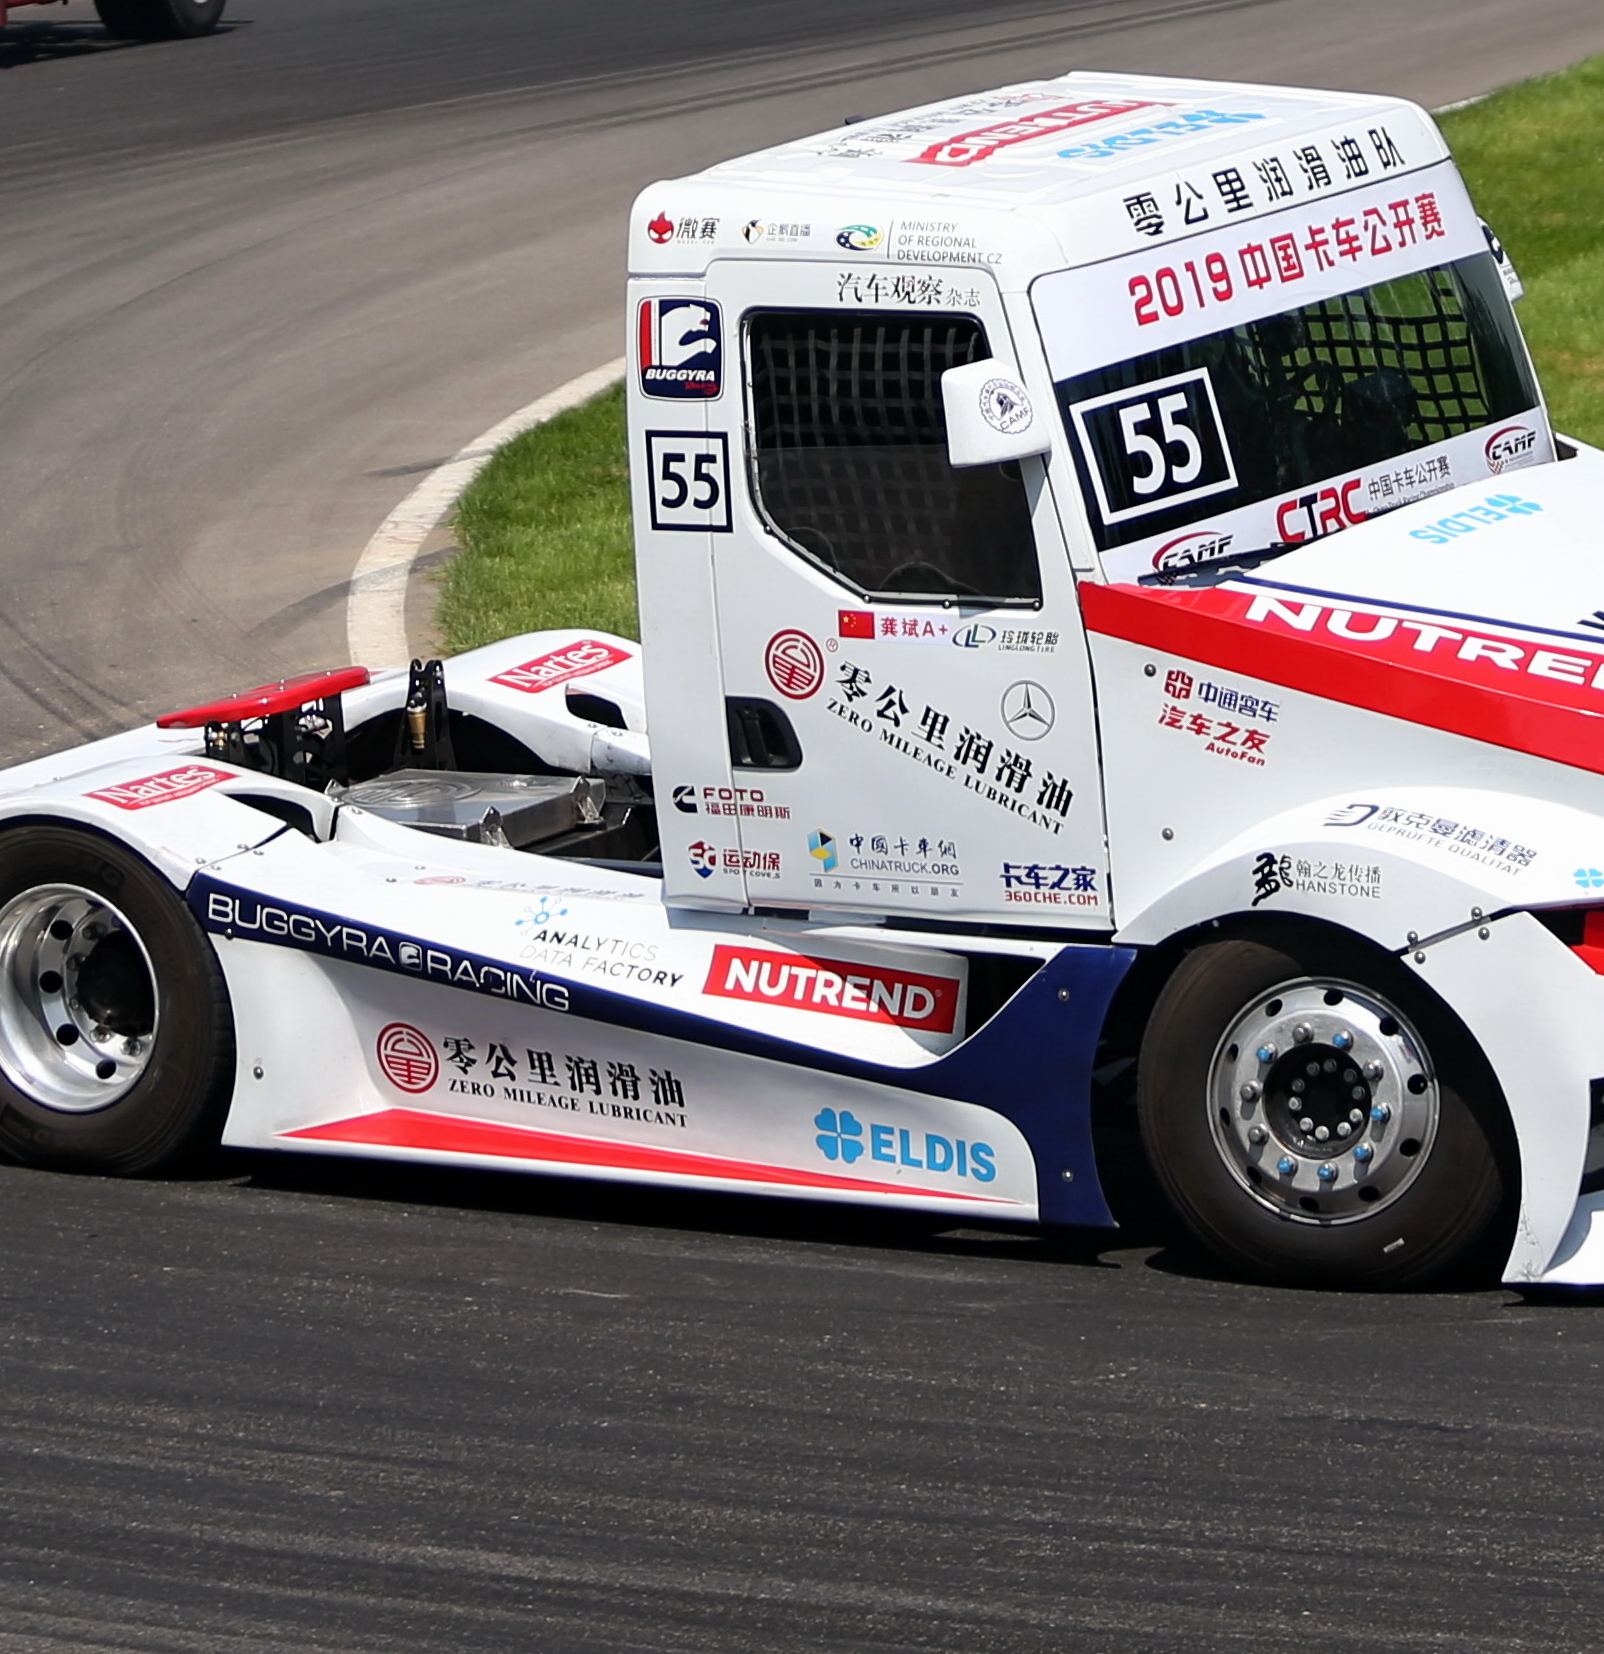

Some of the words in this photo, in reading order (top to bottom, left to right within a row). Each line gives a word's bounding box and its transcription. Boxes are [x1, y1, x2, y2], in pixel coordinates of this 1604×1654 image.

[1122, 125, 1406, 238] 零公里润滑油队
[675, 217, 720, 239] 微赛
[898, 234, 914, 246] OF
[917, 236, 977, 249] REGIONAL
[900, 221, 959, 233] MINISTRY
[897, 249, 984, 264] DEVELOPMENT
[986, 252, 1003, 265] CZ
[1127, 250, 1234, 327] 2019
[1237, 192, 1446, 290] 中国卡车公开赛
[837, 272, 944, 306] 汽车观察
[645, 368, 716, 382] BUGGYRA
[999, 407, 1031, 431] CAMF
[1118, 391, 1204, 496] 55
[1491, 430, 1537, 461] CAMF
[661, 452, 720, 510] 55
[1368, 454, 1452, 501] 中国卡车公开赛
[1275, 477, 1369, 544] CTRC
[1409, 508, 1508, 545] ELDIS
[1161, 533, 1235, 572] CAMF
[999, 629, 1060, 646] 玲珑轮胎
[496, 643, 612, 688] Nartes
[1197, 681, 1280, 723] 中通客车
[834, 659, 1075, 819] 零公里润滑油
[1157, 702, 1272, 755] 汽车之友
[826, 697, 875, 735] ZERO
[878, 728, 958, 783] MILEAGE
[962, 773, 1065, 836] LUBRICANT
[1205, 741, 1266, 767] AutoFan
[92, 768, 217, 805] Nartes
[705, 802, 791, 821] 福田康明斯
[723, 848, 781, 872] 运动保
[850, 857, 960, 877] CHINATRUCK.ORG
[999, 862, 1098, 892] 卡车之家
[1296, 858, 1382, 885] 翰之龙传播
[1004, 890, 1099, 907] 360CHE.COM
[1296, 879, 1381, 899] HANSTONE
[207, 892, 396, 965] BUGGYRA
[426, 949, 570, 1012] RACING
[533, 929, 660, 963] ANALYTICS
[518, 944, 573, 968] DATA
[581, 957, 685, 989] FACTORY
[724, 957, 935, 1020] NUTREND
[443, 1035, 687, 1109] 零公里润滑油
[448, 1078, 496, 1098] ZERO
[502, 1086, 582, 1113] MILEAGE
[587, 1100, 689, 1129] LUBRICANT
[869, 1123, 998, 1183] ELDIS
